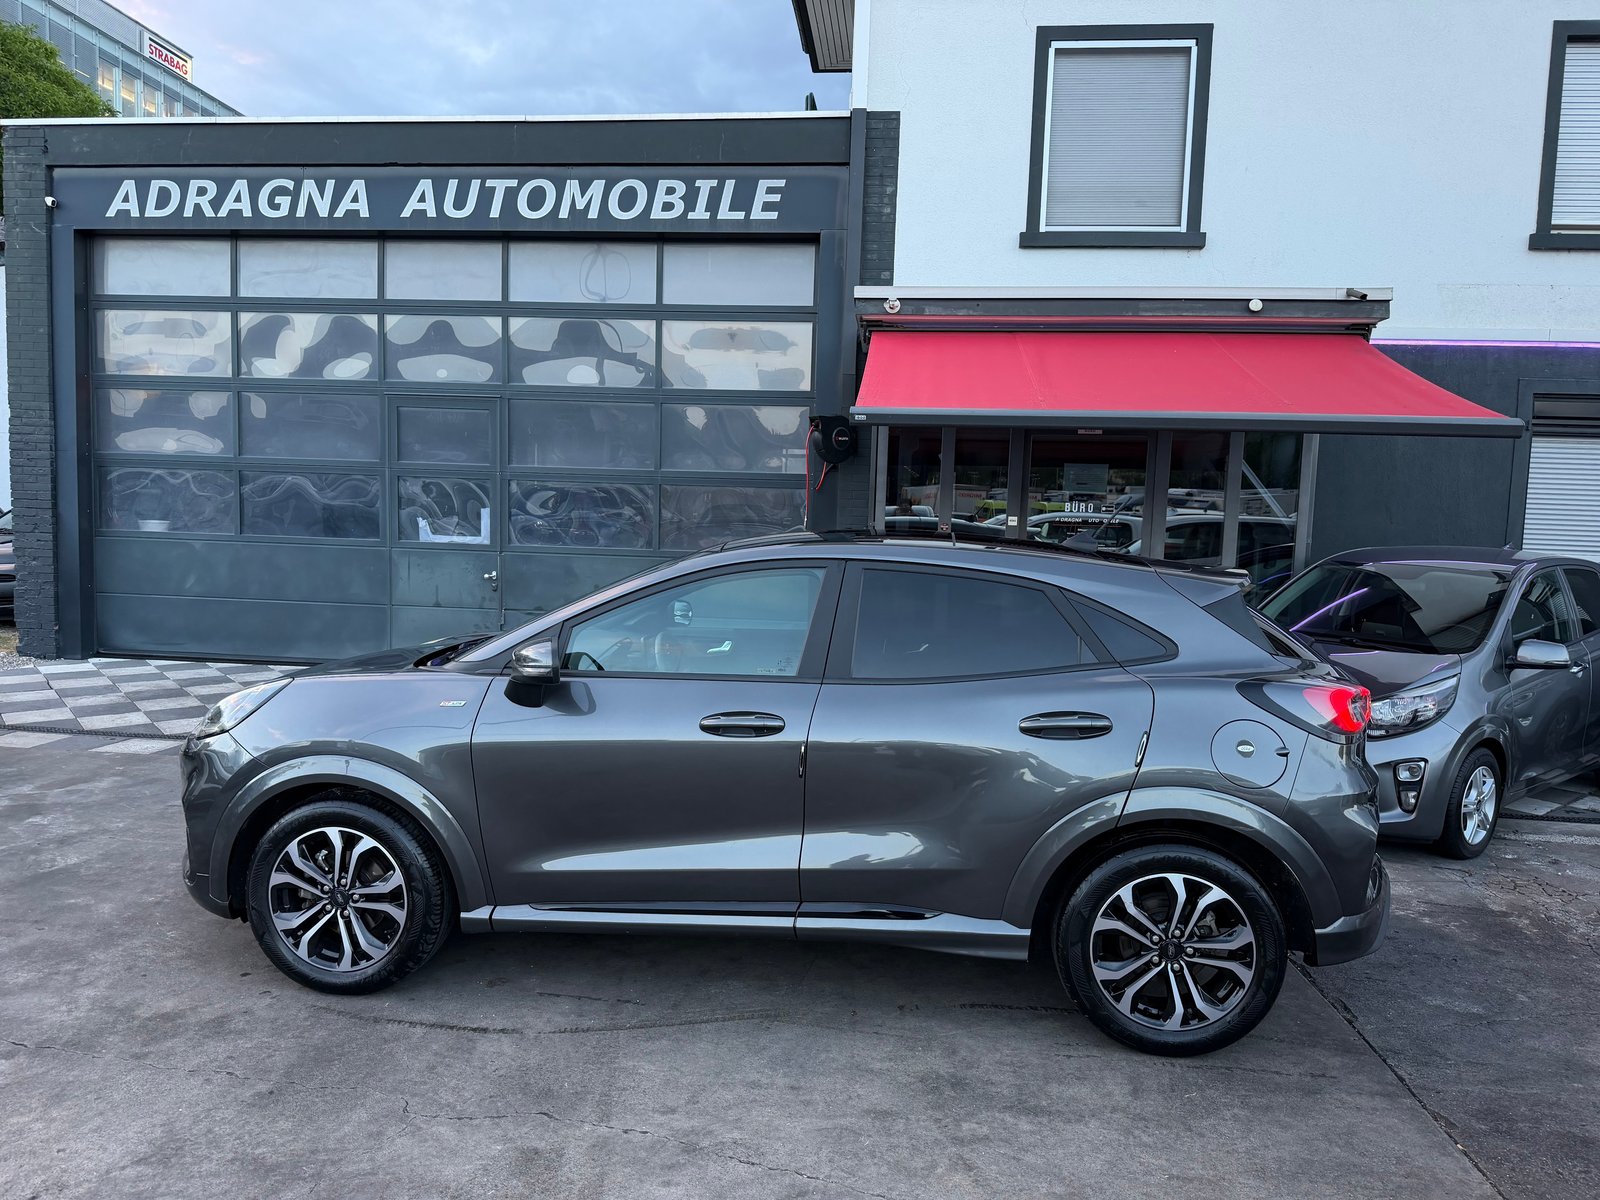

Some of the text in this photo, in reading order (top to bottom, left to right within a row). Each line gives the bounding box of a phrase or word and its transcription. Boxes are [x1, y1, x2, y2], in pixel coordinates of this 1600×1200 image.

[148, 43, 188, 76] STRABAG
[105, 178, 787, 220] ADRAGNA AUTOMOBILE
[1064, 501, 1094, 513] BÜRO
